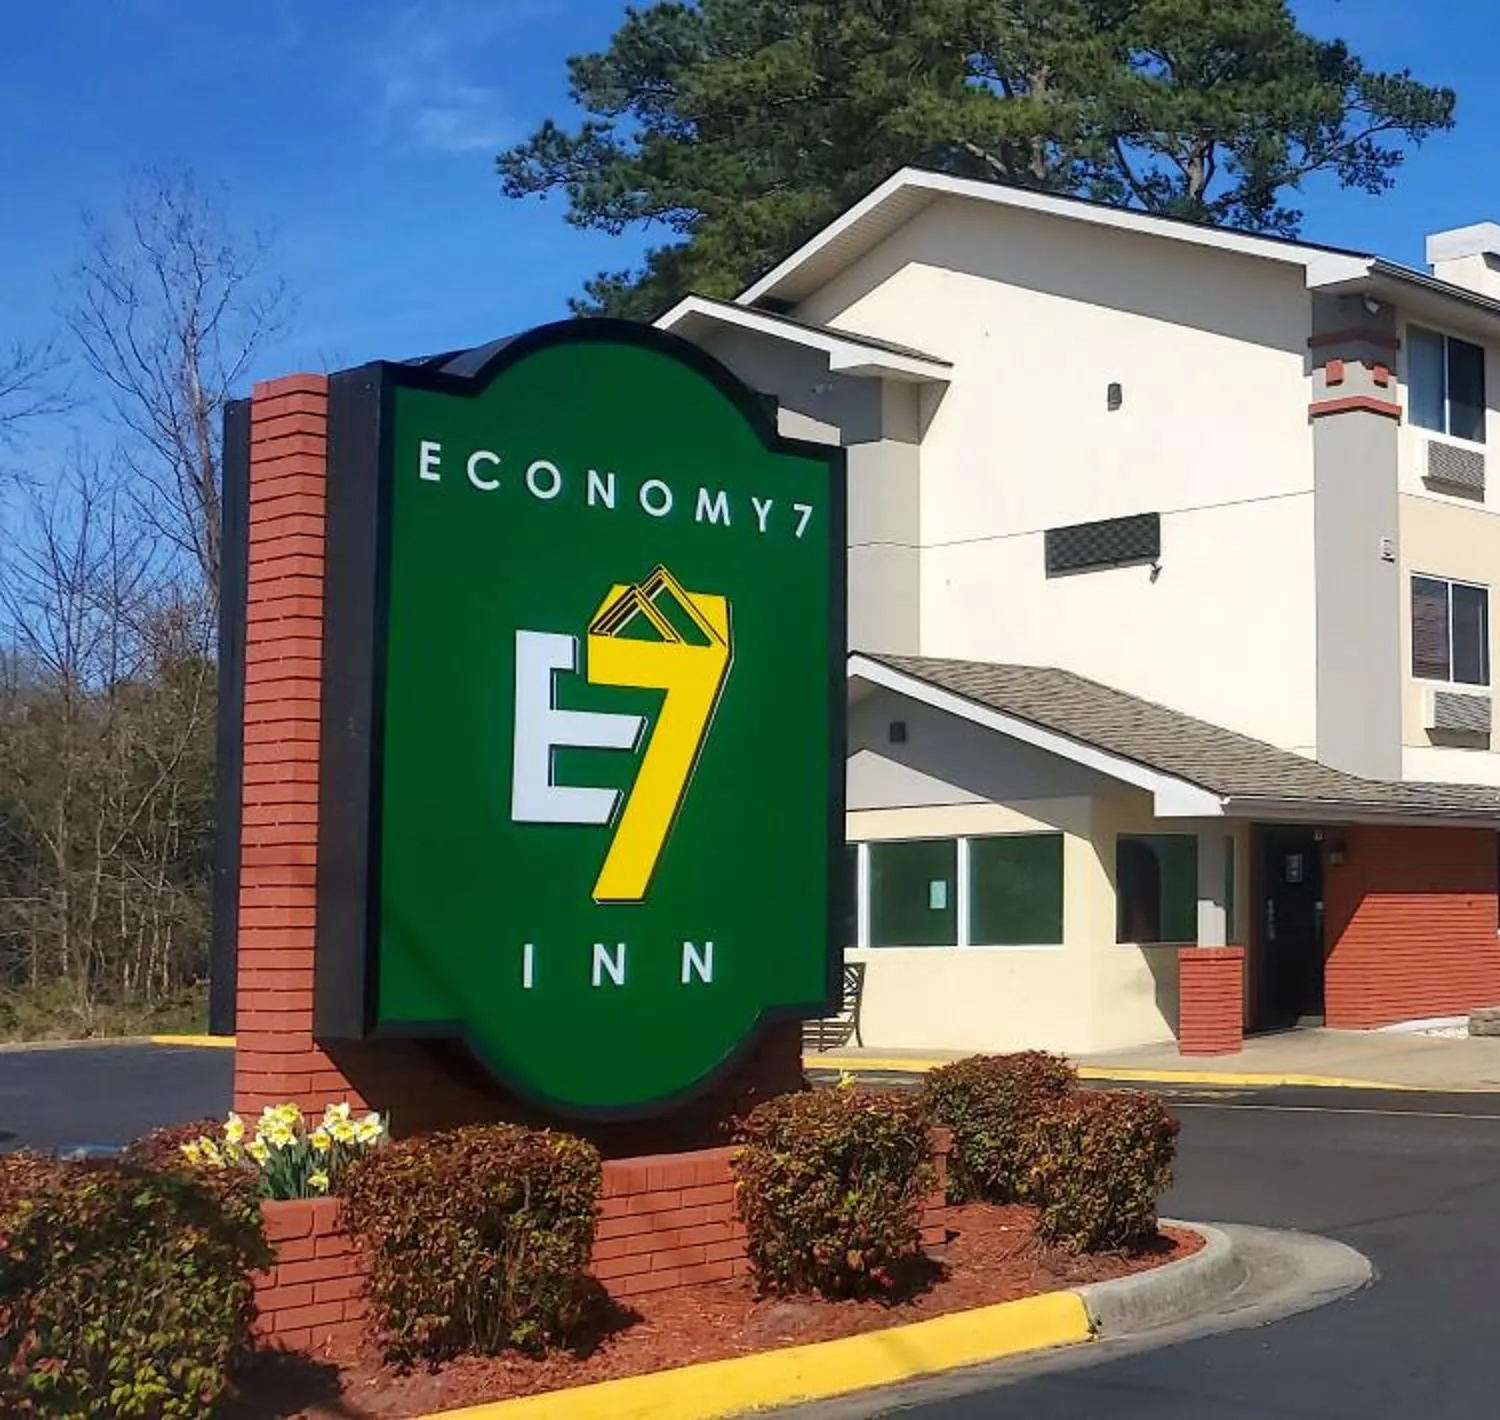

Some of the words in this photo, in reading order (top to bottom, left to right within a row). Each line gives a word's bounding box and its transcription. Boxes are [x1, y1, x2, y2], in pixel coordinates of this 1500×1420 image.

[417, 440, 814, 539] ECONOMY7
[511, 566, 734, 903] E7
[522, 940, 715, 989] INN
